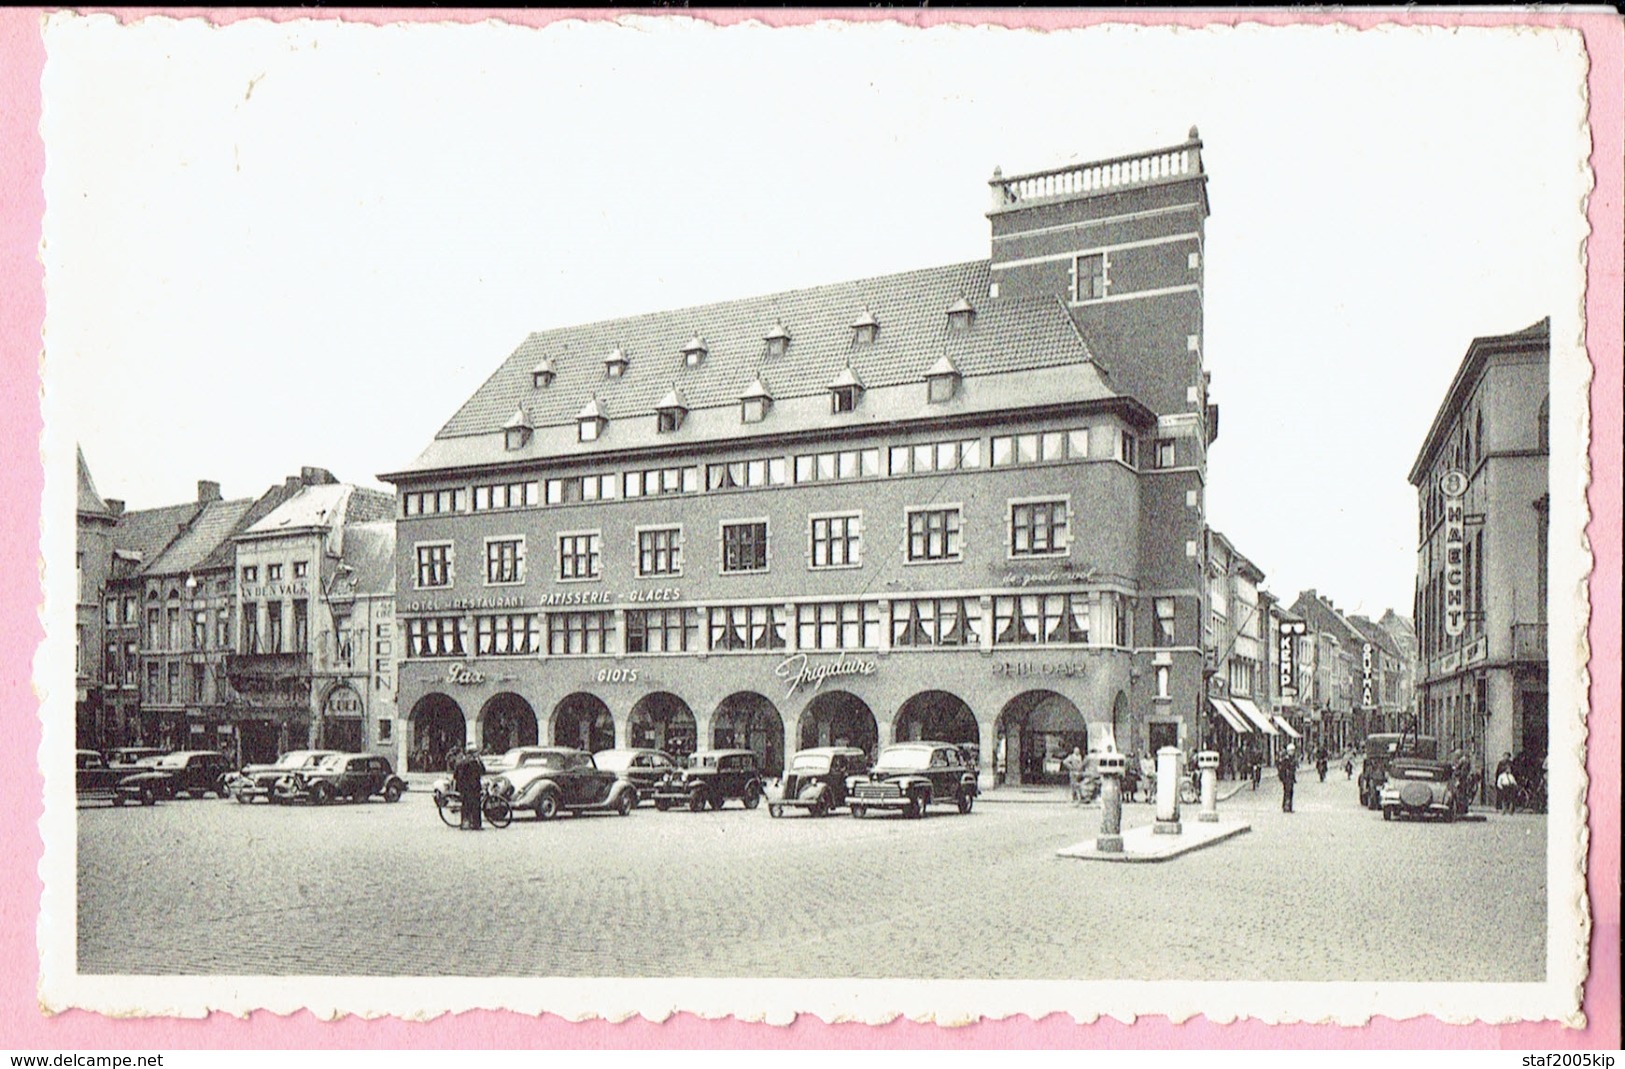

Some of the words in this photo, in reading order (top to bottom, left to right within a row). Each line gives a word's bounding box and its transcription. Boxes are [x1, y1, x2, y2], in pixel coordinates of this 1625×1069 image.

[1447, 506, 1462, 627] HAECHT
[279, 582, 308, 597] VALK
[539, 590, 612, 605] PATISSERIE
[629, 588, 682, 602] GLACES
[406, 599, 440, 612] HOTEL
[453, 595, 525, 608] RESTAURANT
[376, 623, 392, 690] EDEN
[1281, 635, 1291, 687] KEMP
[445, 662, 486, 683] Pax
[597, 668, 639, 682] GIOTS
[775, 651, 879, 698] Frigidaire
